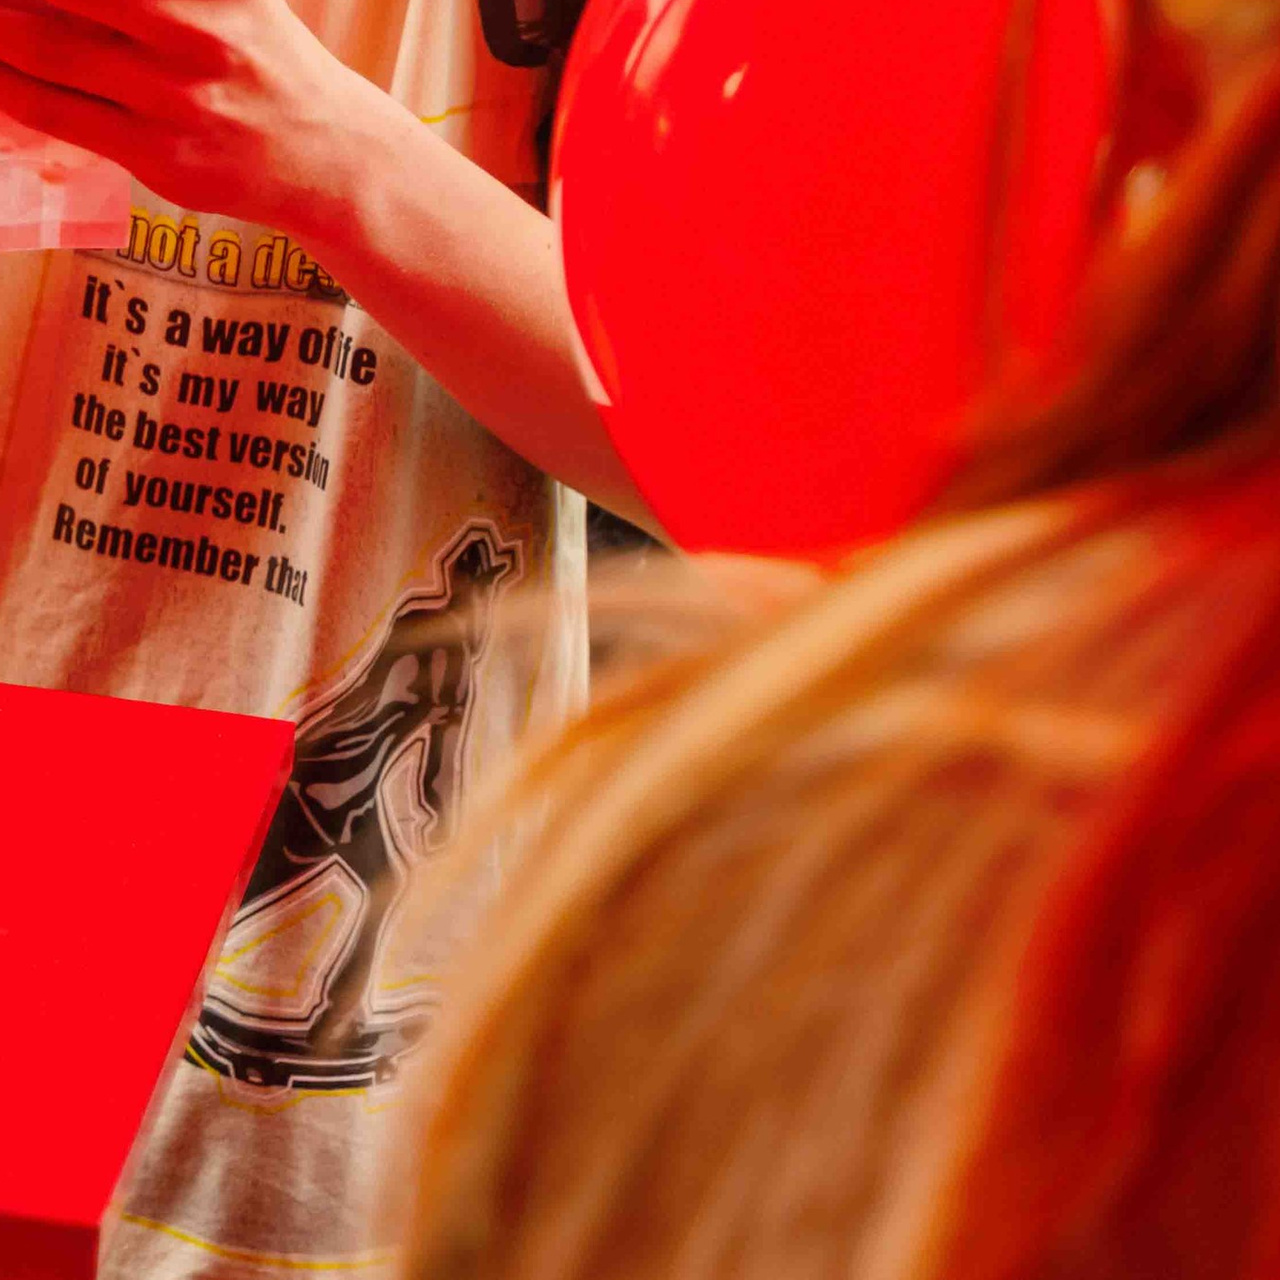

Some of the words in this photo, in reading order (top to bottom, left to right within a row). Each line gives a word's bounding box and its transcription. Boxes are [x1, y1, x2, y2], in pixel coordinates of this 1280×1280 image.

[117, 206, 200, 278] not
[207, 230, 241, 288] a
[165, 309, 191, 348] a
[202, 316, 290, 363] way
[298, 326, 338, 370] of
[177, 371, 240, 413] my
[256, 380, 325, 428] way
[72, 392, 126, 441] the
[132, 410, 221, 461] best
[228, 431, 330, 491] version
[75, 456, 111, 495] of
[122, 470, 287, 534] yourself.
[52, 502, 260, 586] Remember
[264, 555, 308, 607] that
